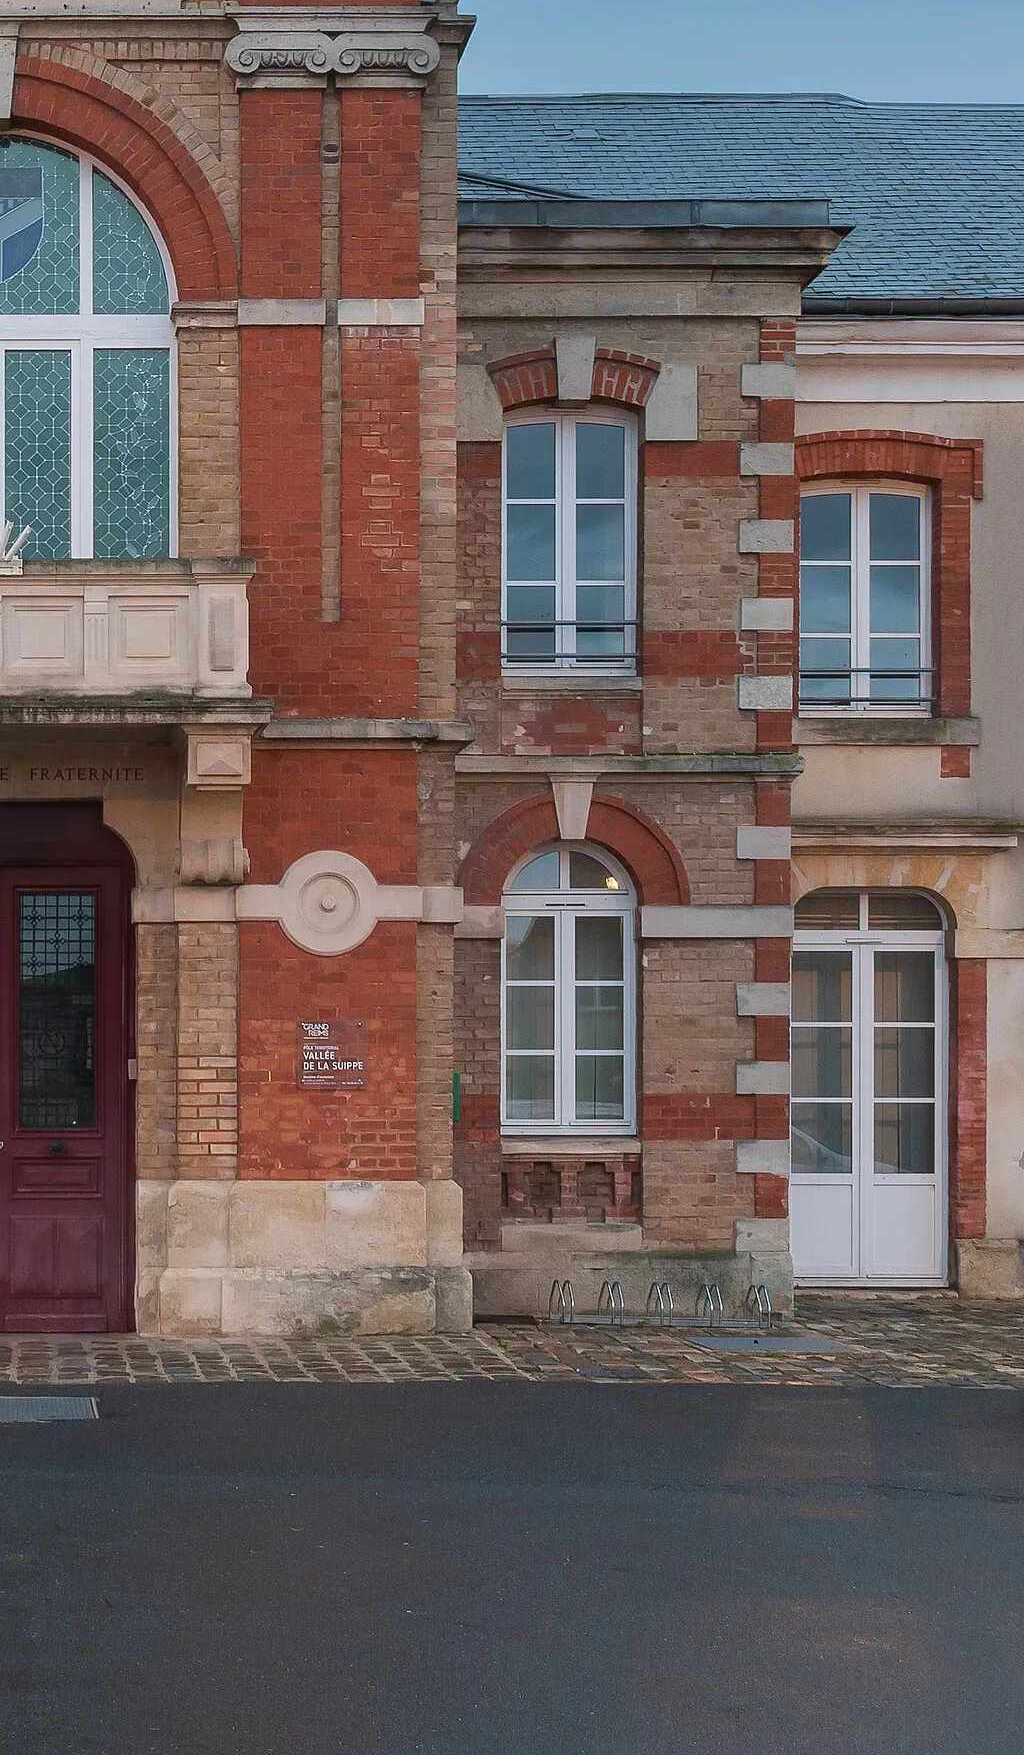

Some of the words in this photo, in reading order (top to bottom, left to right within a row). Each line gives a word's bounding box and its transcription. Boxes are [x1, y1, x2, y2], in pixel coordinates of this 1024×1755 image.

[30, 767, 145, 781] FRATERNITE
[303, 1050, 335, 1060] VALLÉE
[303, 1061, 314, 1070] DE
[318, 1061, 329, 1070] LA
[332, 1061, 364, 1070] SUIPPE
